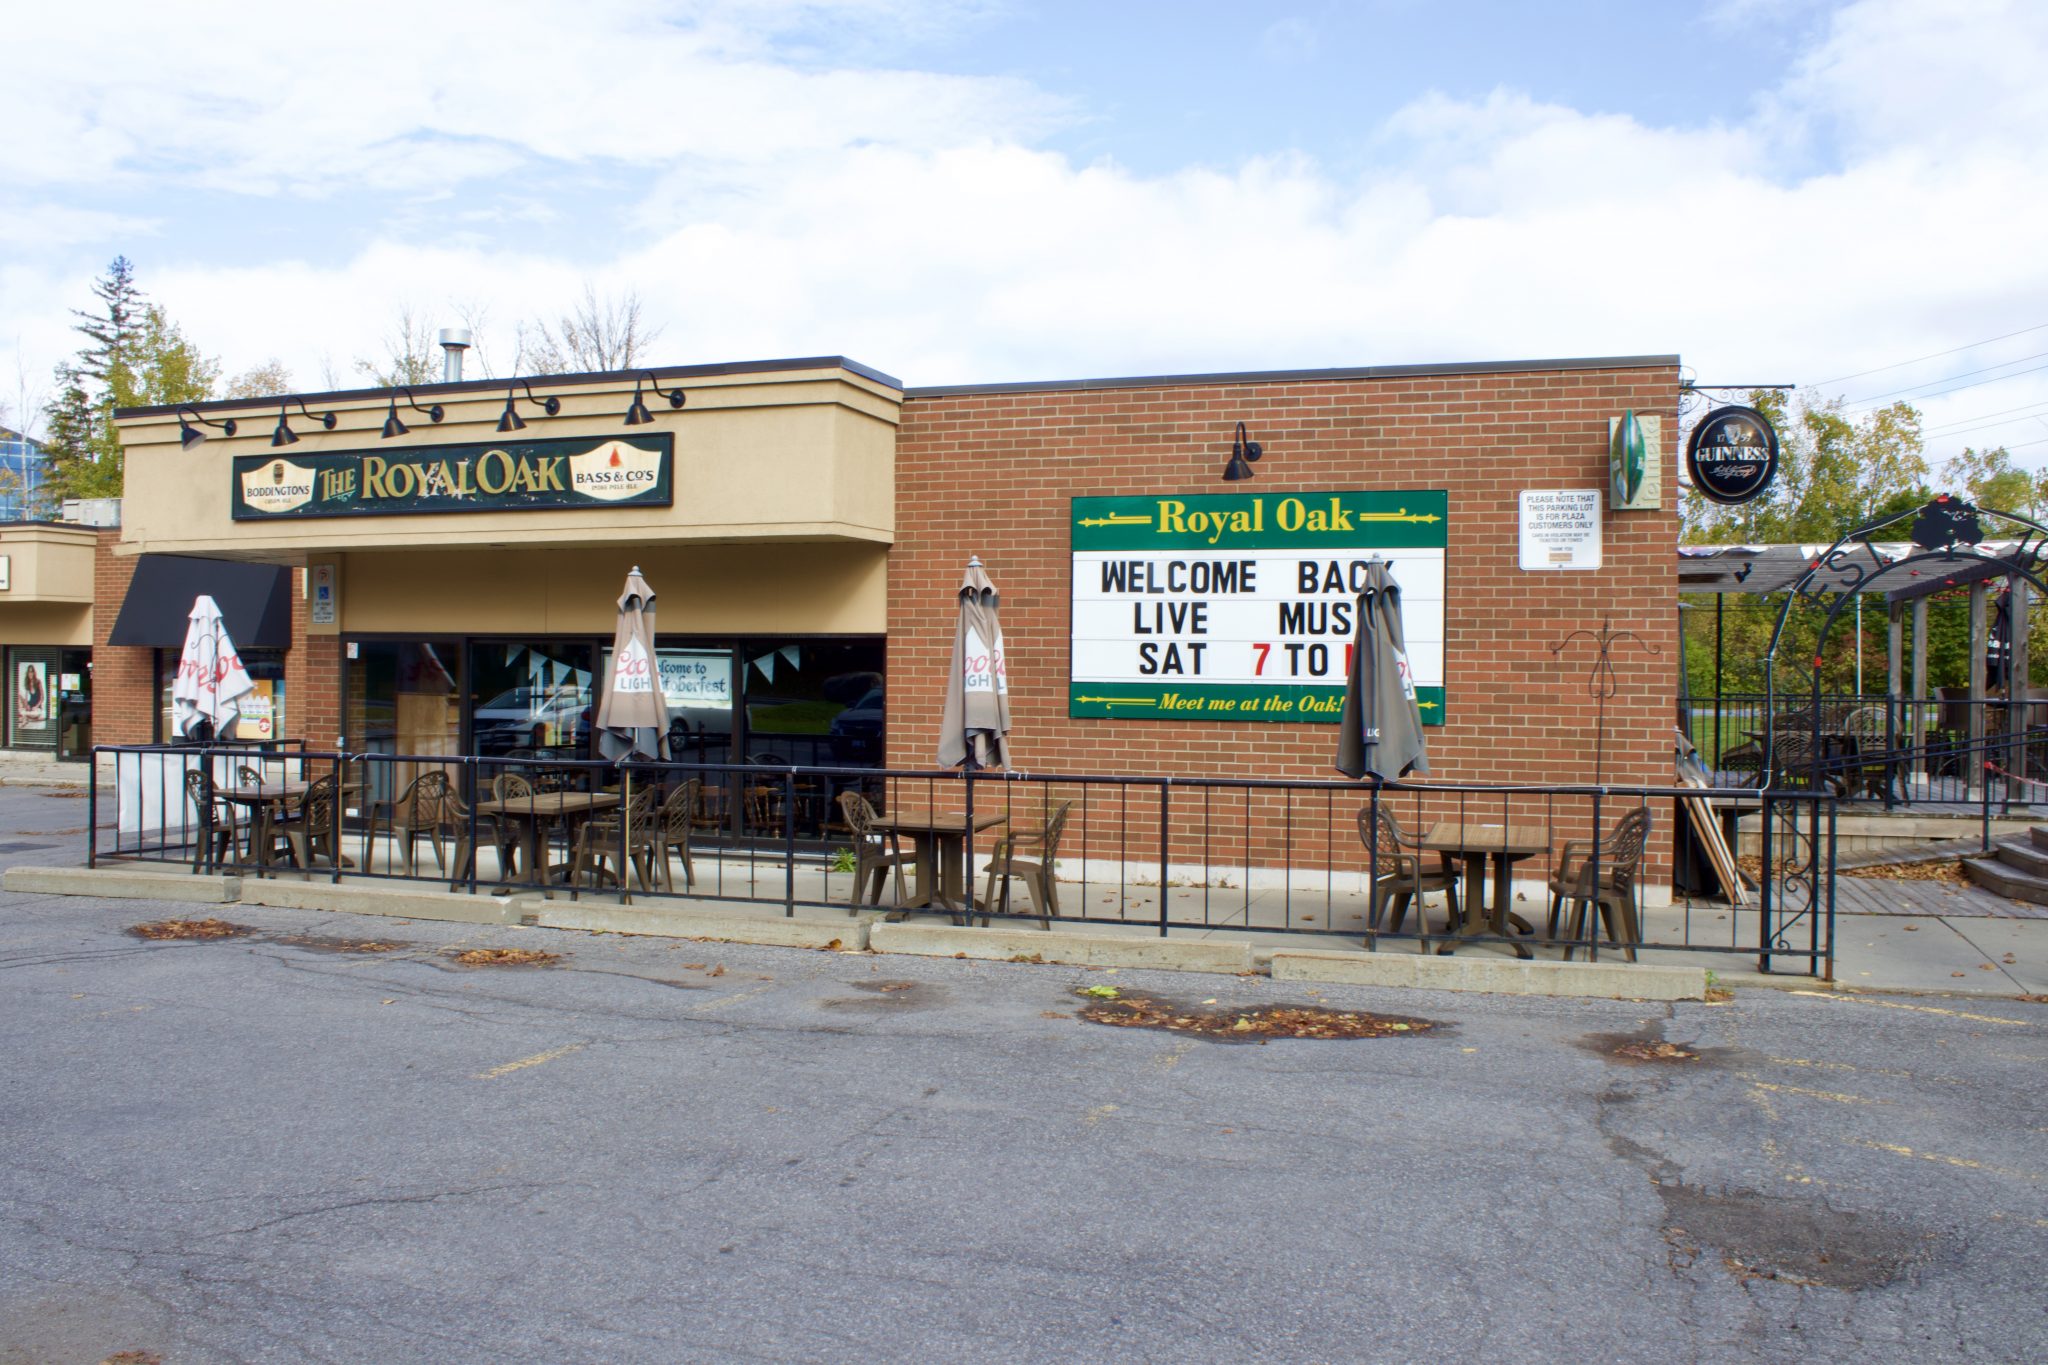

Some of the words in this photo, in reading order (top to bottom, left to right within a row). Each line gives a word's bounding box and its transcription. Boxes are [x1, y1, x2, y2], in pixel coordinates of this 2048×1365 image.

[1695, 447, 1770, 461] GUINNESS
[319, 468, 355, 501] THE
[361, 456, 477, 499] ROYAL
[476, 450, 565, 494] OAK
[576, 472, 611, 483] BASS
[614, 471, 623, 482] &
[247, 485, 310, 497] BODDINGTONS
[1527, 495, 1554, 503] PLEASE
[1577, 494, 1595, 502] THAT
[1528, 504, 1545, 512] THIS
[1580, 503, 1594, 511] LOT
[1156, 499, 1264, 544] Royal
[1276, 498, 1355, 532] Oak
[1562, 512, 1585, 520] PLAZA
[1528, 521, 1573, 530] CUSTOMERS
[1574, 521, 1594, 529] ONLY
[1102, 561, 1256, 594] WELCOME
[1134, 602, 1207, 634] LIVE
[1279, 602, 1352, 635] MUS
[1139, 642, 1207, 675] SAT
[1253, 643, 1271, 676] 7
[1284, 644, 1328, 676] TO
[659, 659, 692, 674] lcome
[695, 662, 707, 674] to
[621, 677, 650, 689] LIGH
[1158, 693, 1205, 710] Meet
[1207, 699, 1236, 711] me
[1240, 698, 1260, 711] at
[1263, 695, 1293, 711] the
[1298, 695, 1346, 713] Oak!
